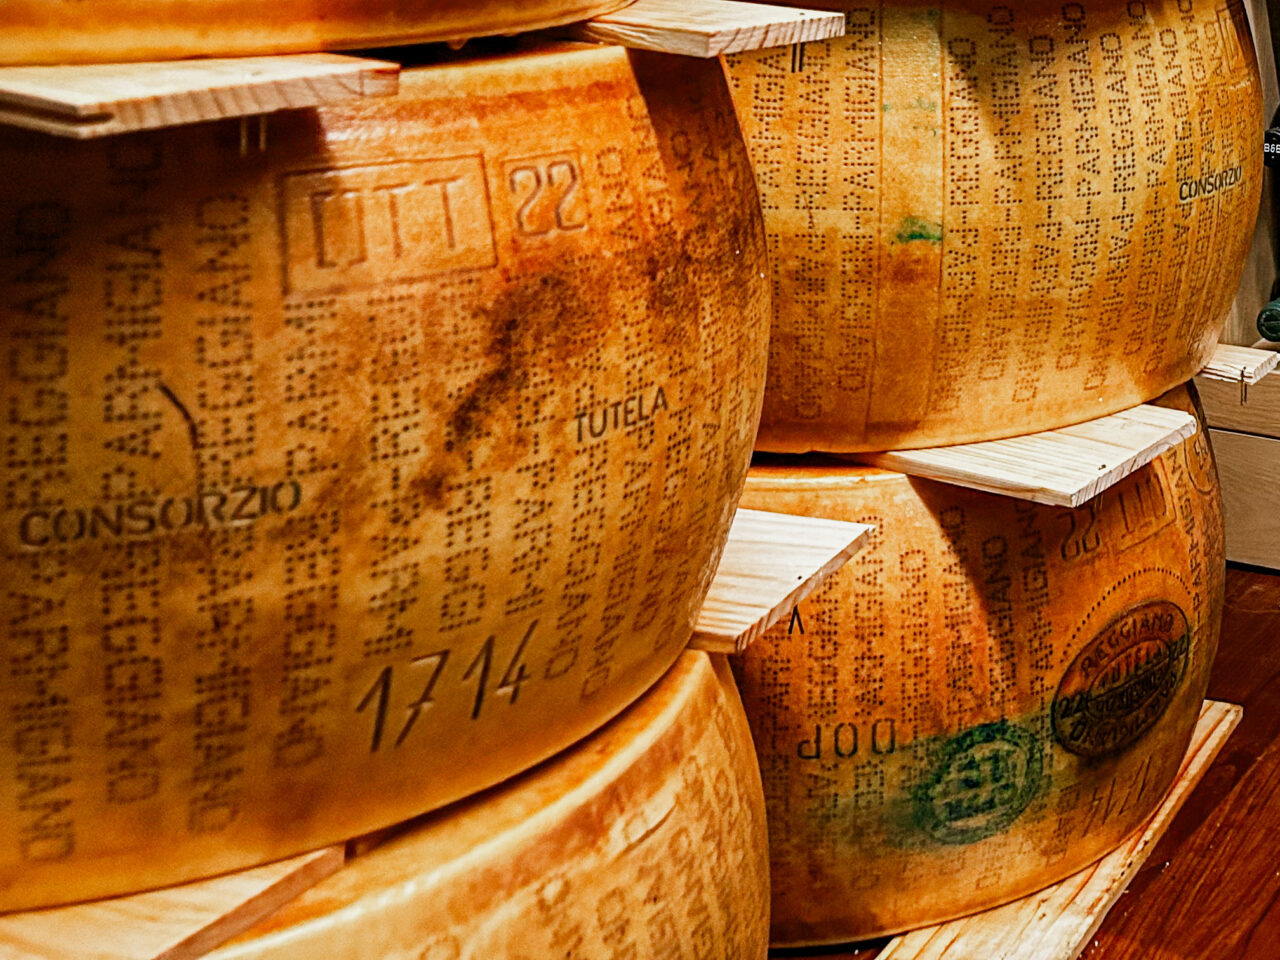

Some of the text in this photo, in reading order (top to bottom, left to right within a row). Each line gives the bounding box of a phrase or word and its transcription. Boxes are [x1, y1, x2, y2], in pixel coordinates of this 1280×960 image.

[311, 159, 588, 271] OTT 22
[1178, 165, 1243, 202] CONSORZIO
[574, 385, 669, 443] TUTELA
[19, 480, 303, 549] CONSORZIO
[355, 619, 539, 754] 1714
[798, 718, 897, 760] DOP
